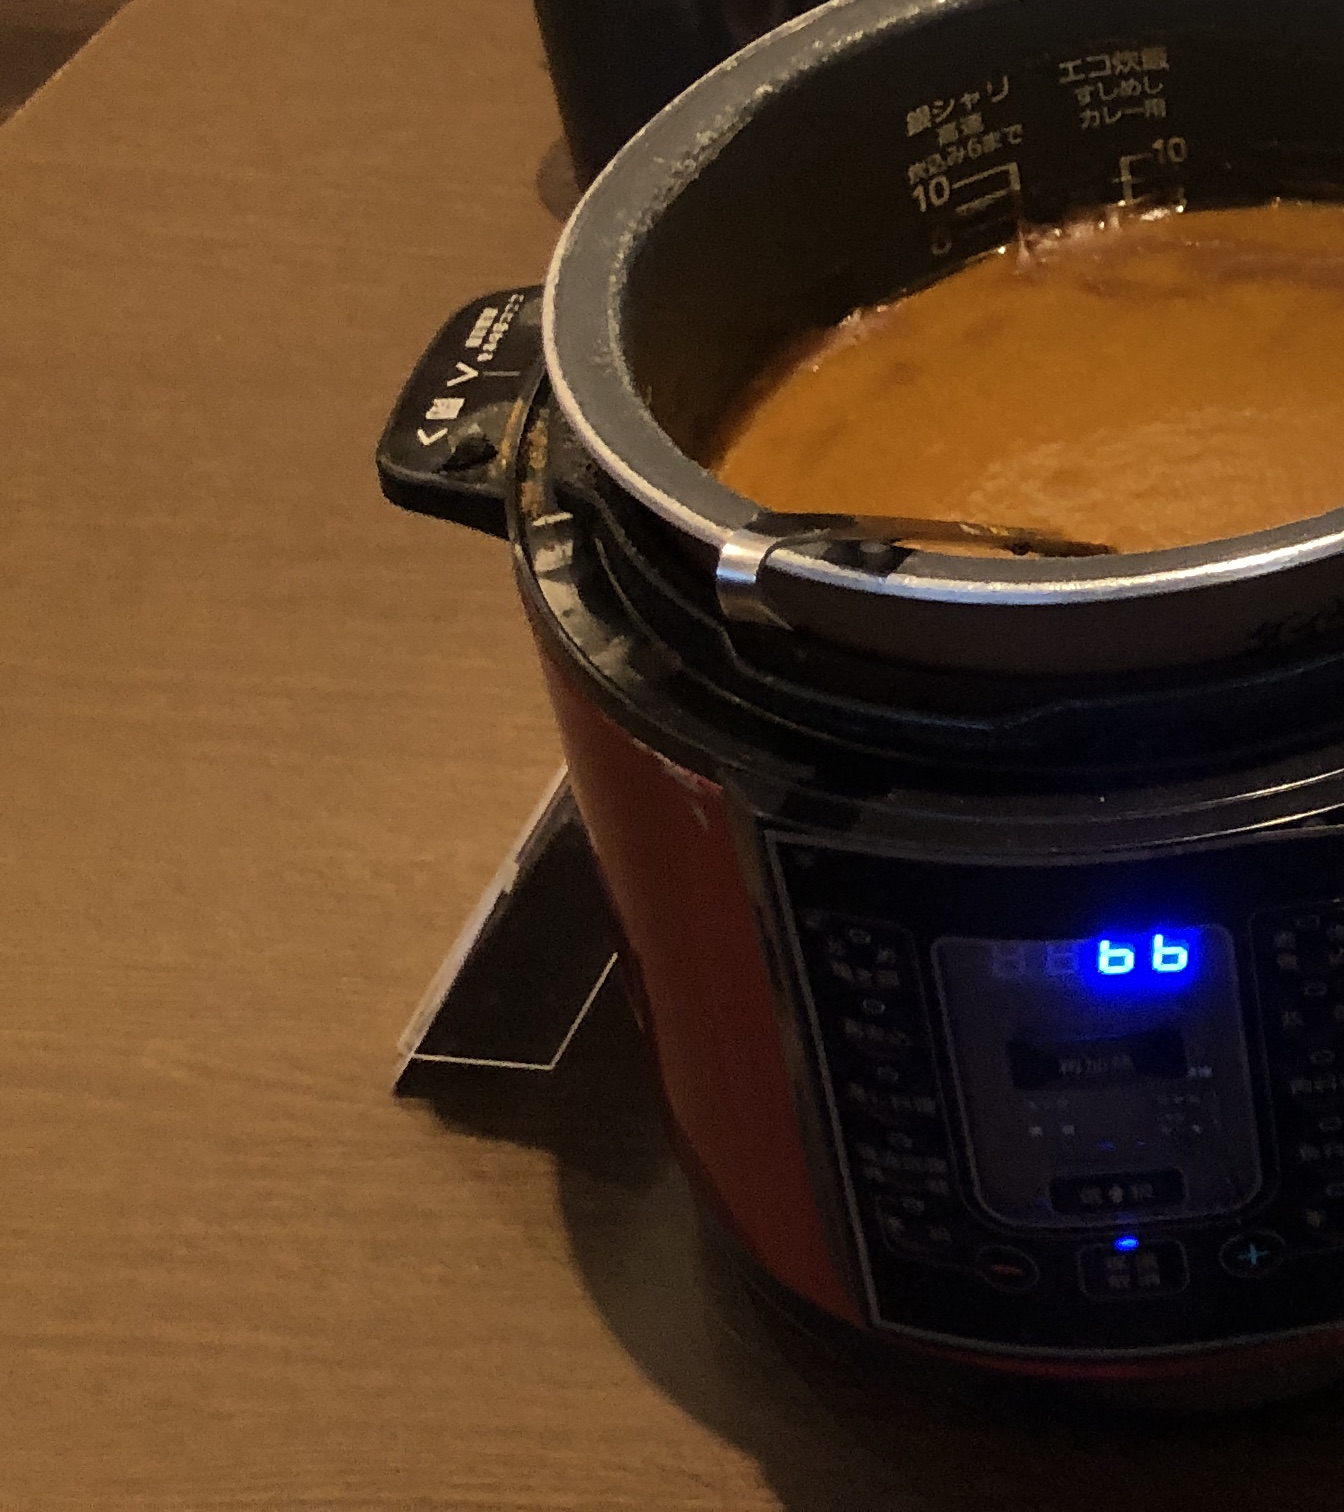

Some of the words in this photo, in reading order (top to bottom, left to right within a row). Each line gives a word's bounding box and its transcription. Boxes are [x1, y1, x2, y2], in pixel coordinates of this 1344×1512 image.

[1074, 76, 1163, 106] すしめし
[1079, 98, 1167, 130] カレー用
[1152, 137, 1188, 164] 10
[911, 175, 950, 213] 10
